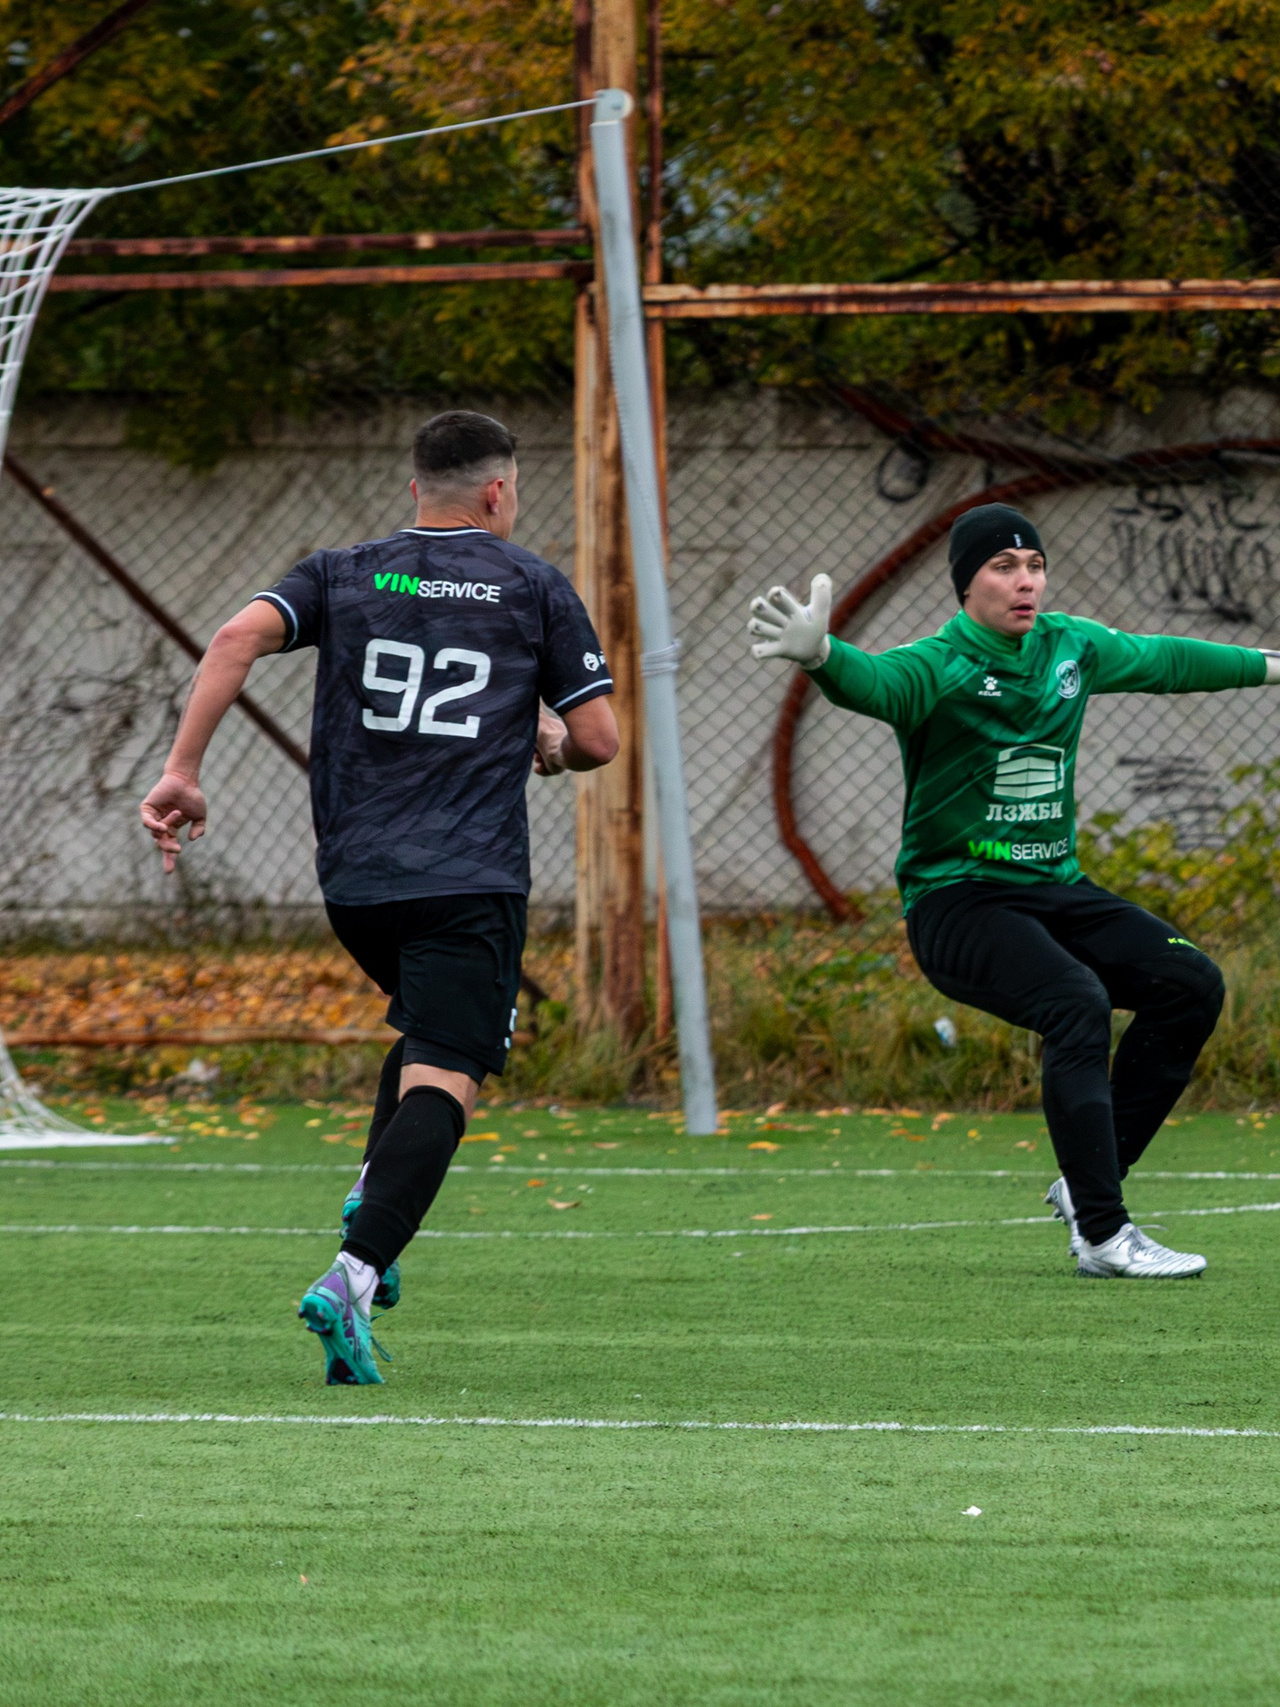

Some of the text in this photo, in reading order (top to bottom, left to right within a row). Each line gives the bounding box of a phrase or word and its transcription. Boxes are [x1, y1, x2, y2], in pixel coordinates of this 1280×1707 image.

[373, 572, 502, 603] VINSERVICE
[361, 637, 491, 739] 92
[985, 800, 1063, 822] ЛЗЖБИ
[967, 837, 1068, 861] VINSERVICE
